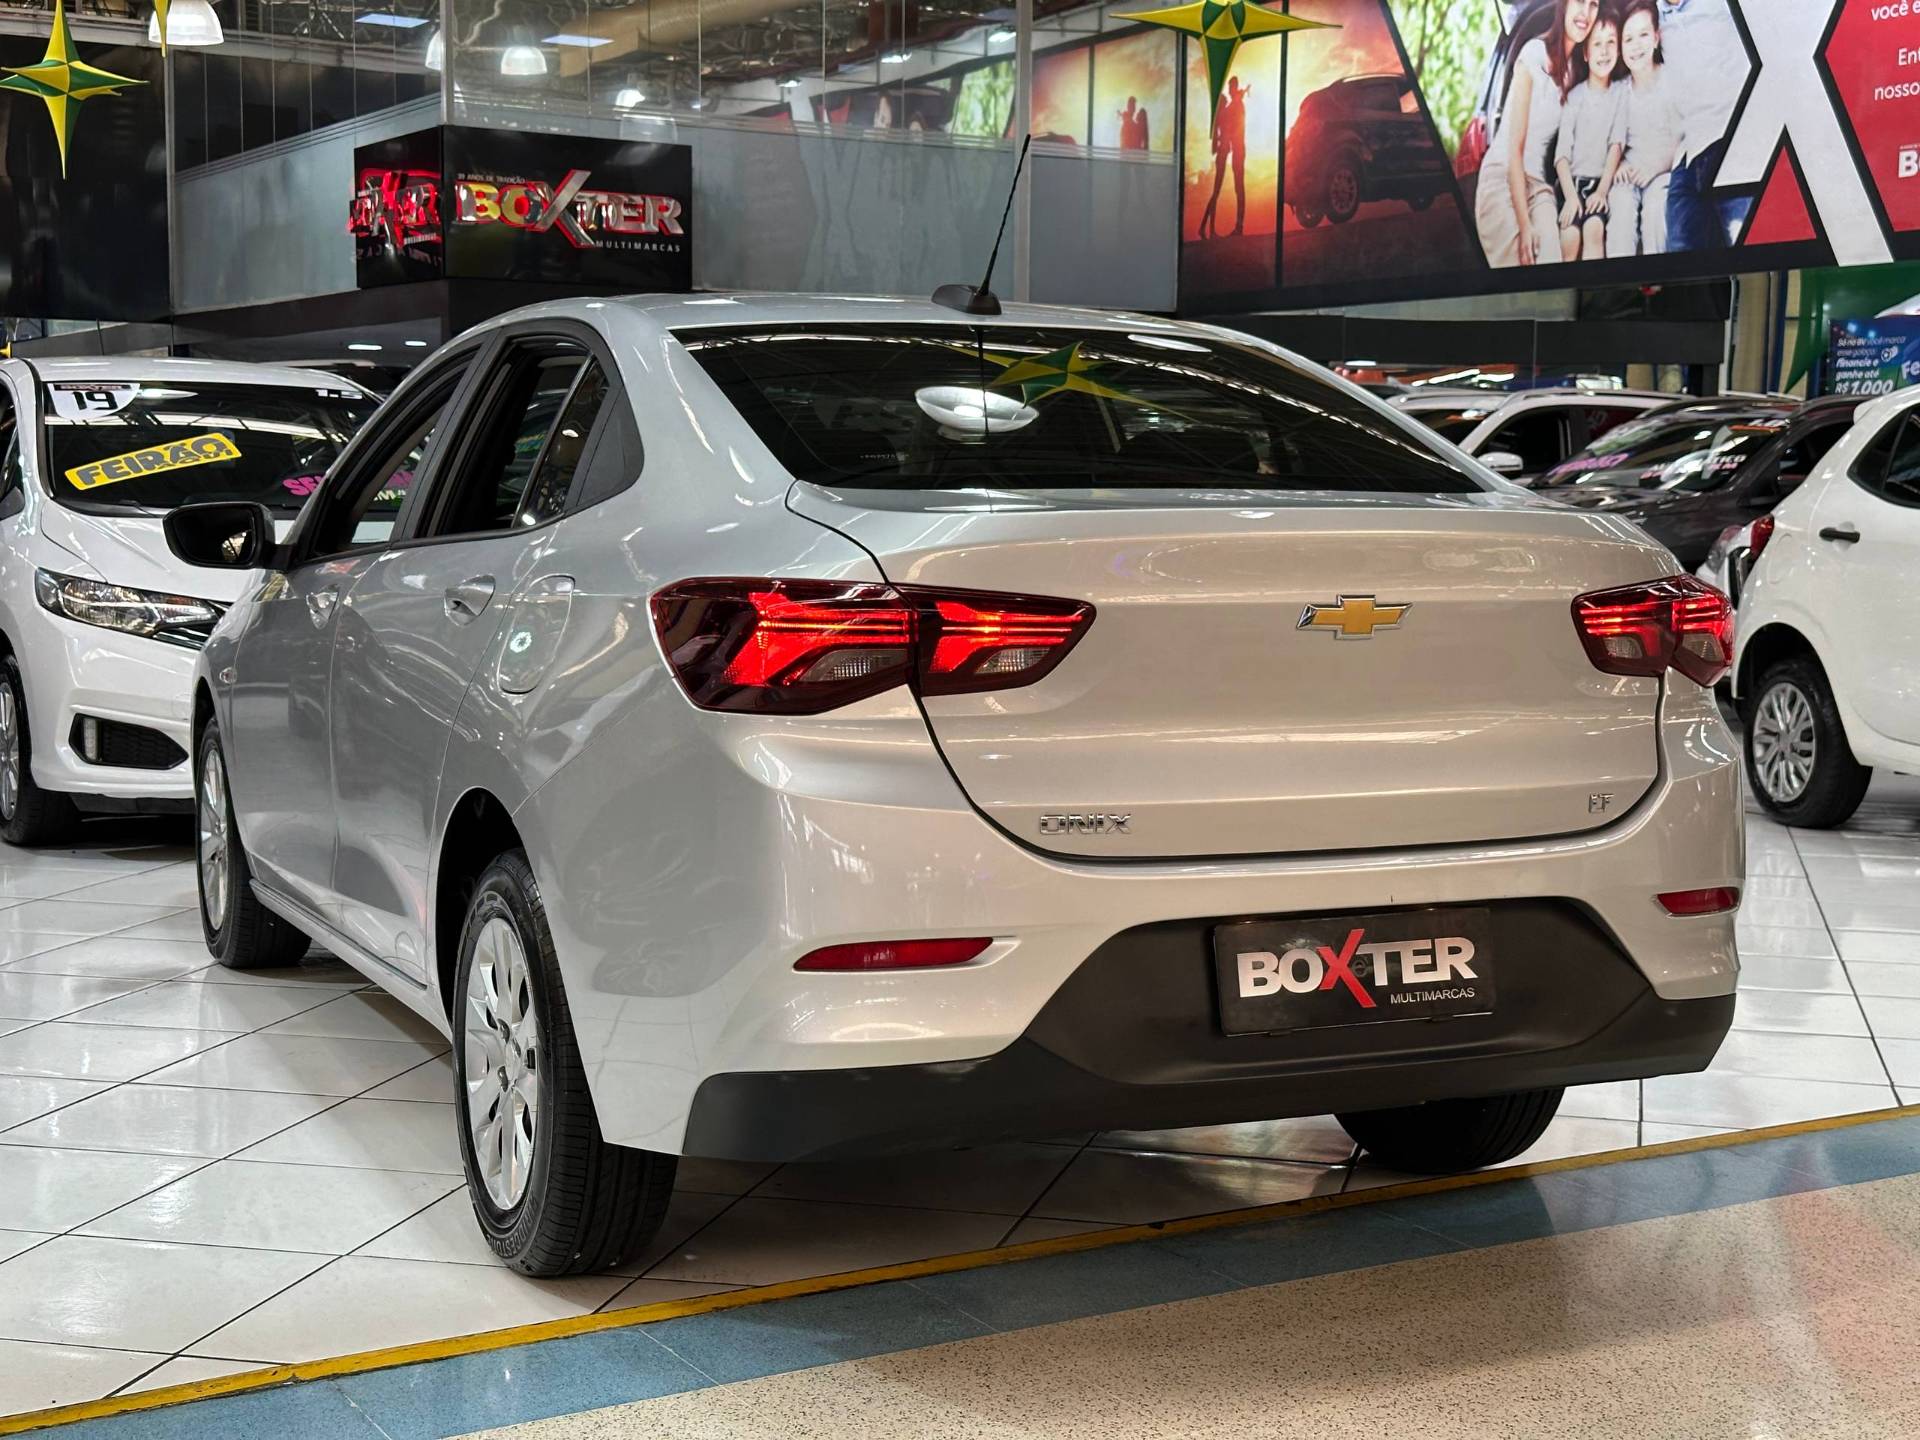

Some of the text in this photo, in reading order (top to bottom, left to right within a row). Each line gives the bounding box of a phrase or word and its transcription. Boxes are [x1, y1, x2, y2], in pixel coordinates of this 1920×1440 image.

[454, 169, 684, 248] BOXTER
[595, 240, 681, 253] MULTIMARCAS
[1835, 380, 1894, 395] R$ 1.000
[72, 391, 119, 411] 19
[76, 437, 229, 486] FEIRÃO
[1039, 813, 1132, 835] ONIX
[1236, 928, 1479, 1009] BOXTER
[1390, 987, 1476, 1005] MULTIMARCAS
